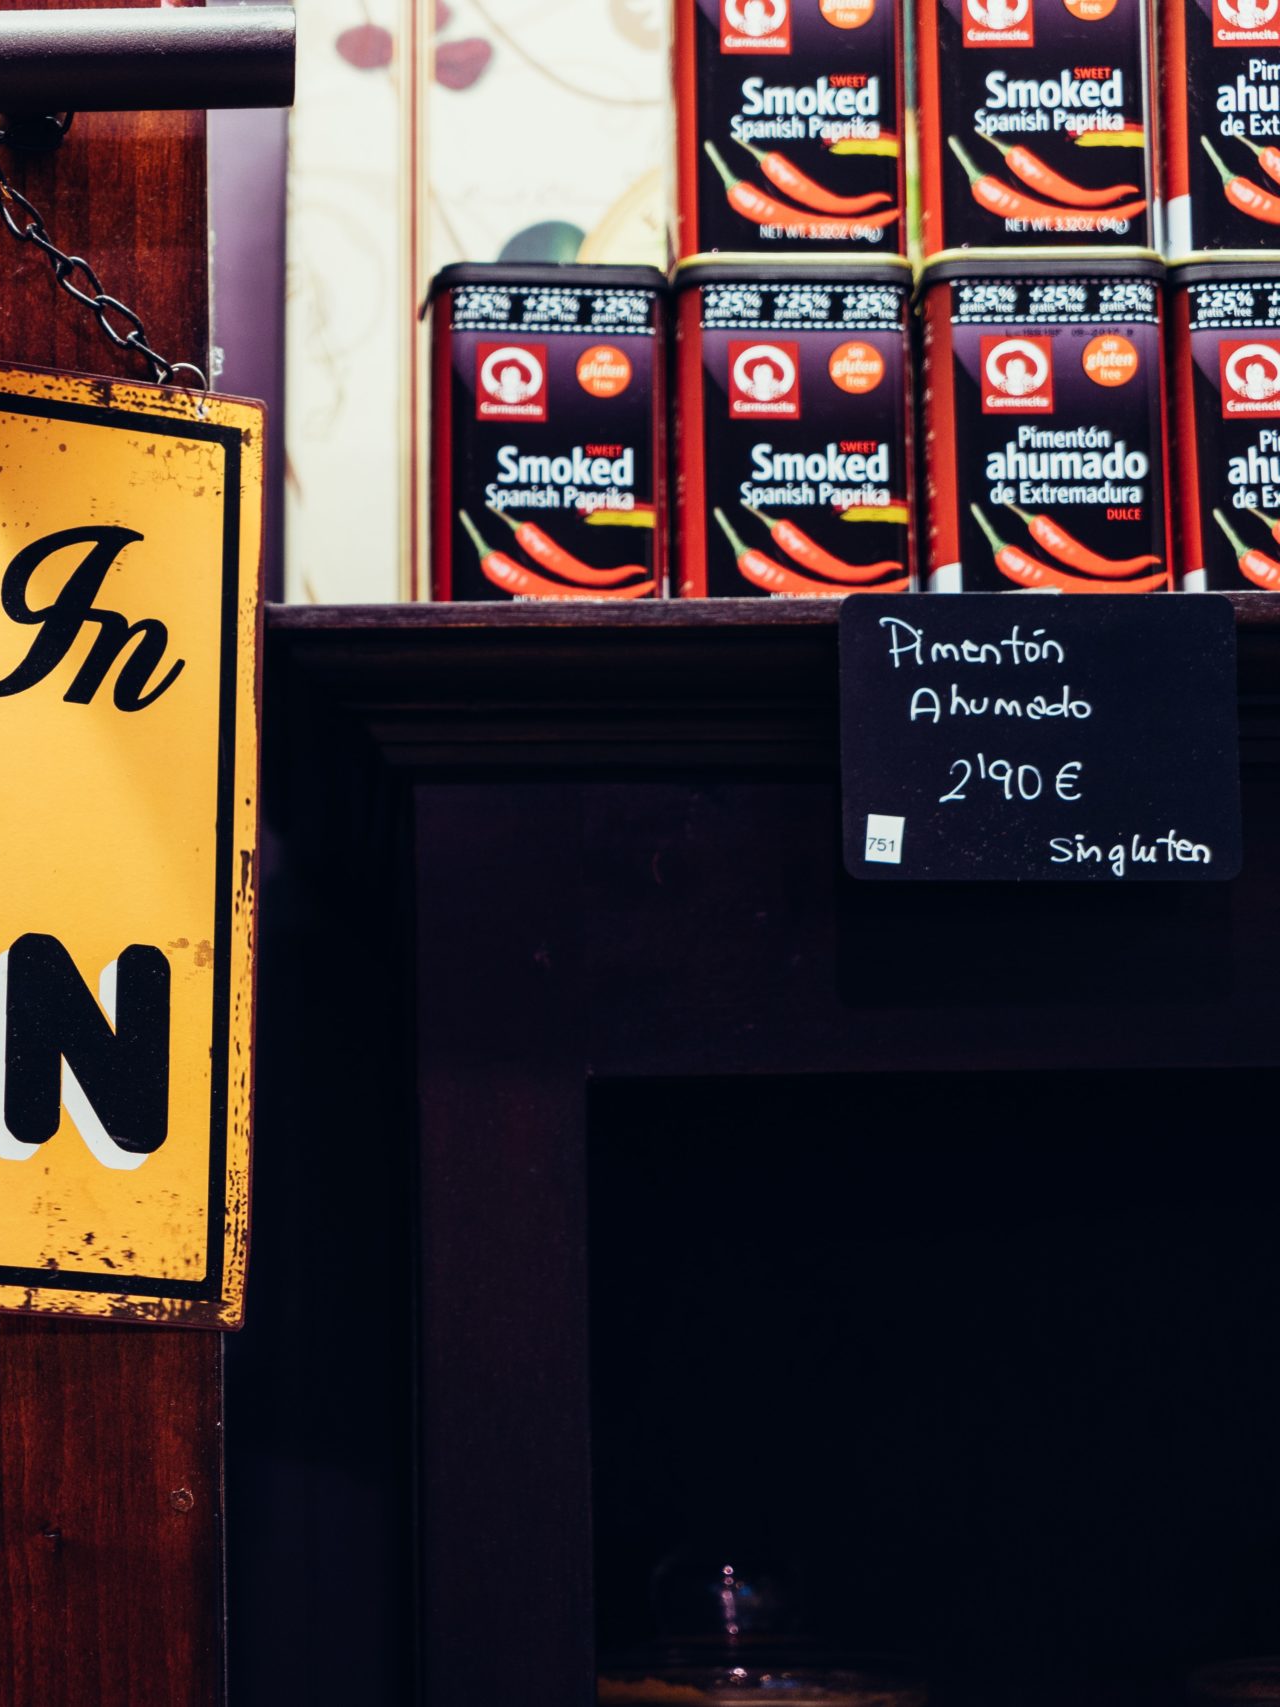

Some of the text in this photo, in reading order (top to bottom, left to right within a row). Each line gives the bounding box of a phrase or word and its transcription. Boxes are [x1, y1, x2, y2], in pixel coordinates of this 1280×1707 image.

[1080, 3, 1101, 14] free
[967, 30, 1029, 41] Carmencita
[1217, 29, 1280, 40] Carmencita
[829, 75, 867, 87] SWEET
[1074, 66, 1111, 79] SWEET
[741, 76, 880, 116] Smoked
[985, 69, 1123, 109] Smoked
[1216, 74, 1280, 113] ahu
[730, 114, 881, 143] Spanish Paprika
[973, 108, 1125, 136] Spanish Paprika
[1220, 113, 1280, 136] de Ext
[760, 225, 784, 239] NET
[1005, 218, 1028, 232] NET
[1096, 218, 1130, 234] (94g)
[455, 293, 648, 318] +25% +25% +25%
[705, 291, 900, 314] +25% +25% +25%
[959, 284, 1154, 307] +25% +25% +25%
[1197, 291, 1254, 312] +25%
[832, 359, 880, 377] gluten
[1086, 352, 1134, 370] gluten
[1100, 369, 1121, 380] free
[986, 395, 1049, 407] Carmencita
[840, 441, 877, 453] SWEET
[1019, 425, 1111, 448] Pimentón
[1260, 430, 1280, 452] Pi
[585, 444, 624, 457] SWEET
[986, 441, 1148, 480] ahumado
[497, 445, 634, 486] Smoked
[751, 443, 889, 482] Smoked
[485, 483, 635, 513] Spanish Paprika
[740, 481, 891, 510] Spanish Paprika
[990, 480, 1144, 504] de Extremadura
[1233, 486, 1258, 508] de
[1106, 507, 1142, 521] DULCE
[879, 616, 1064, 668] Pimentón
[910, 684, 1092, 723] Ahumado
[867, 837, 896, 853] 751
